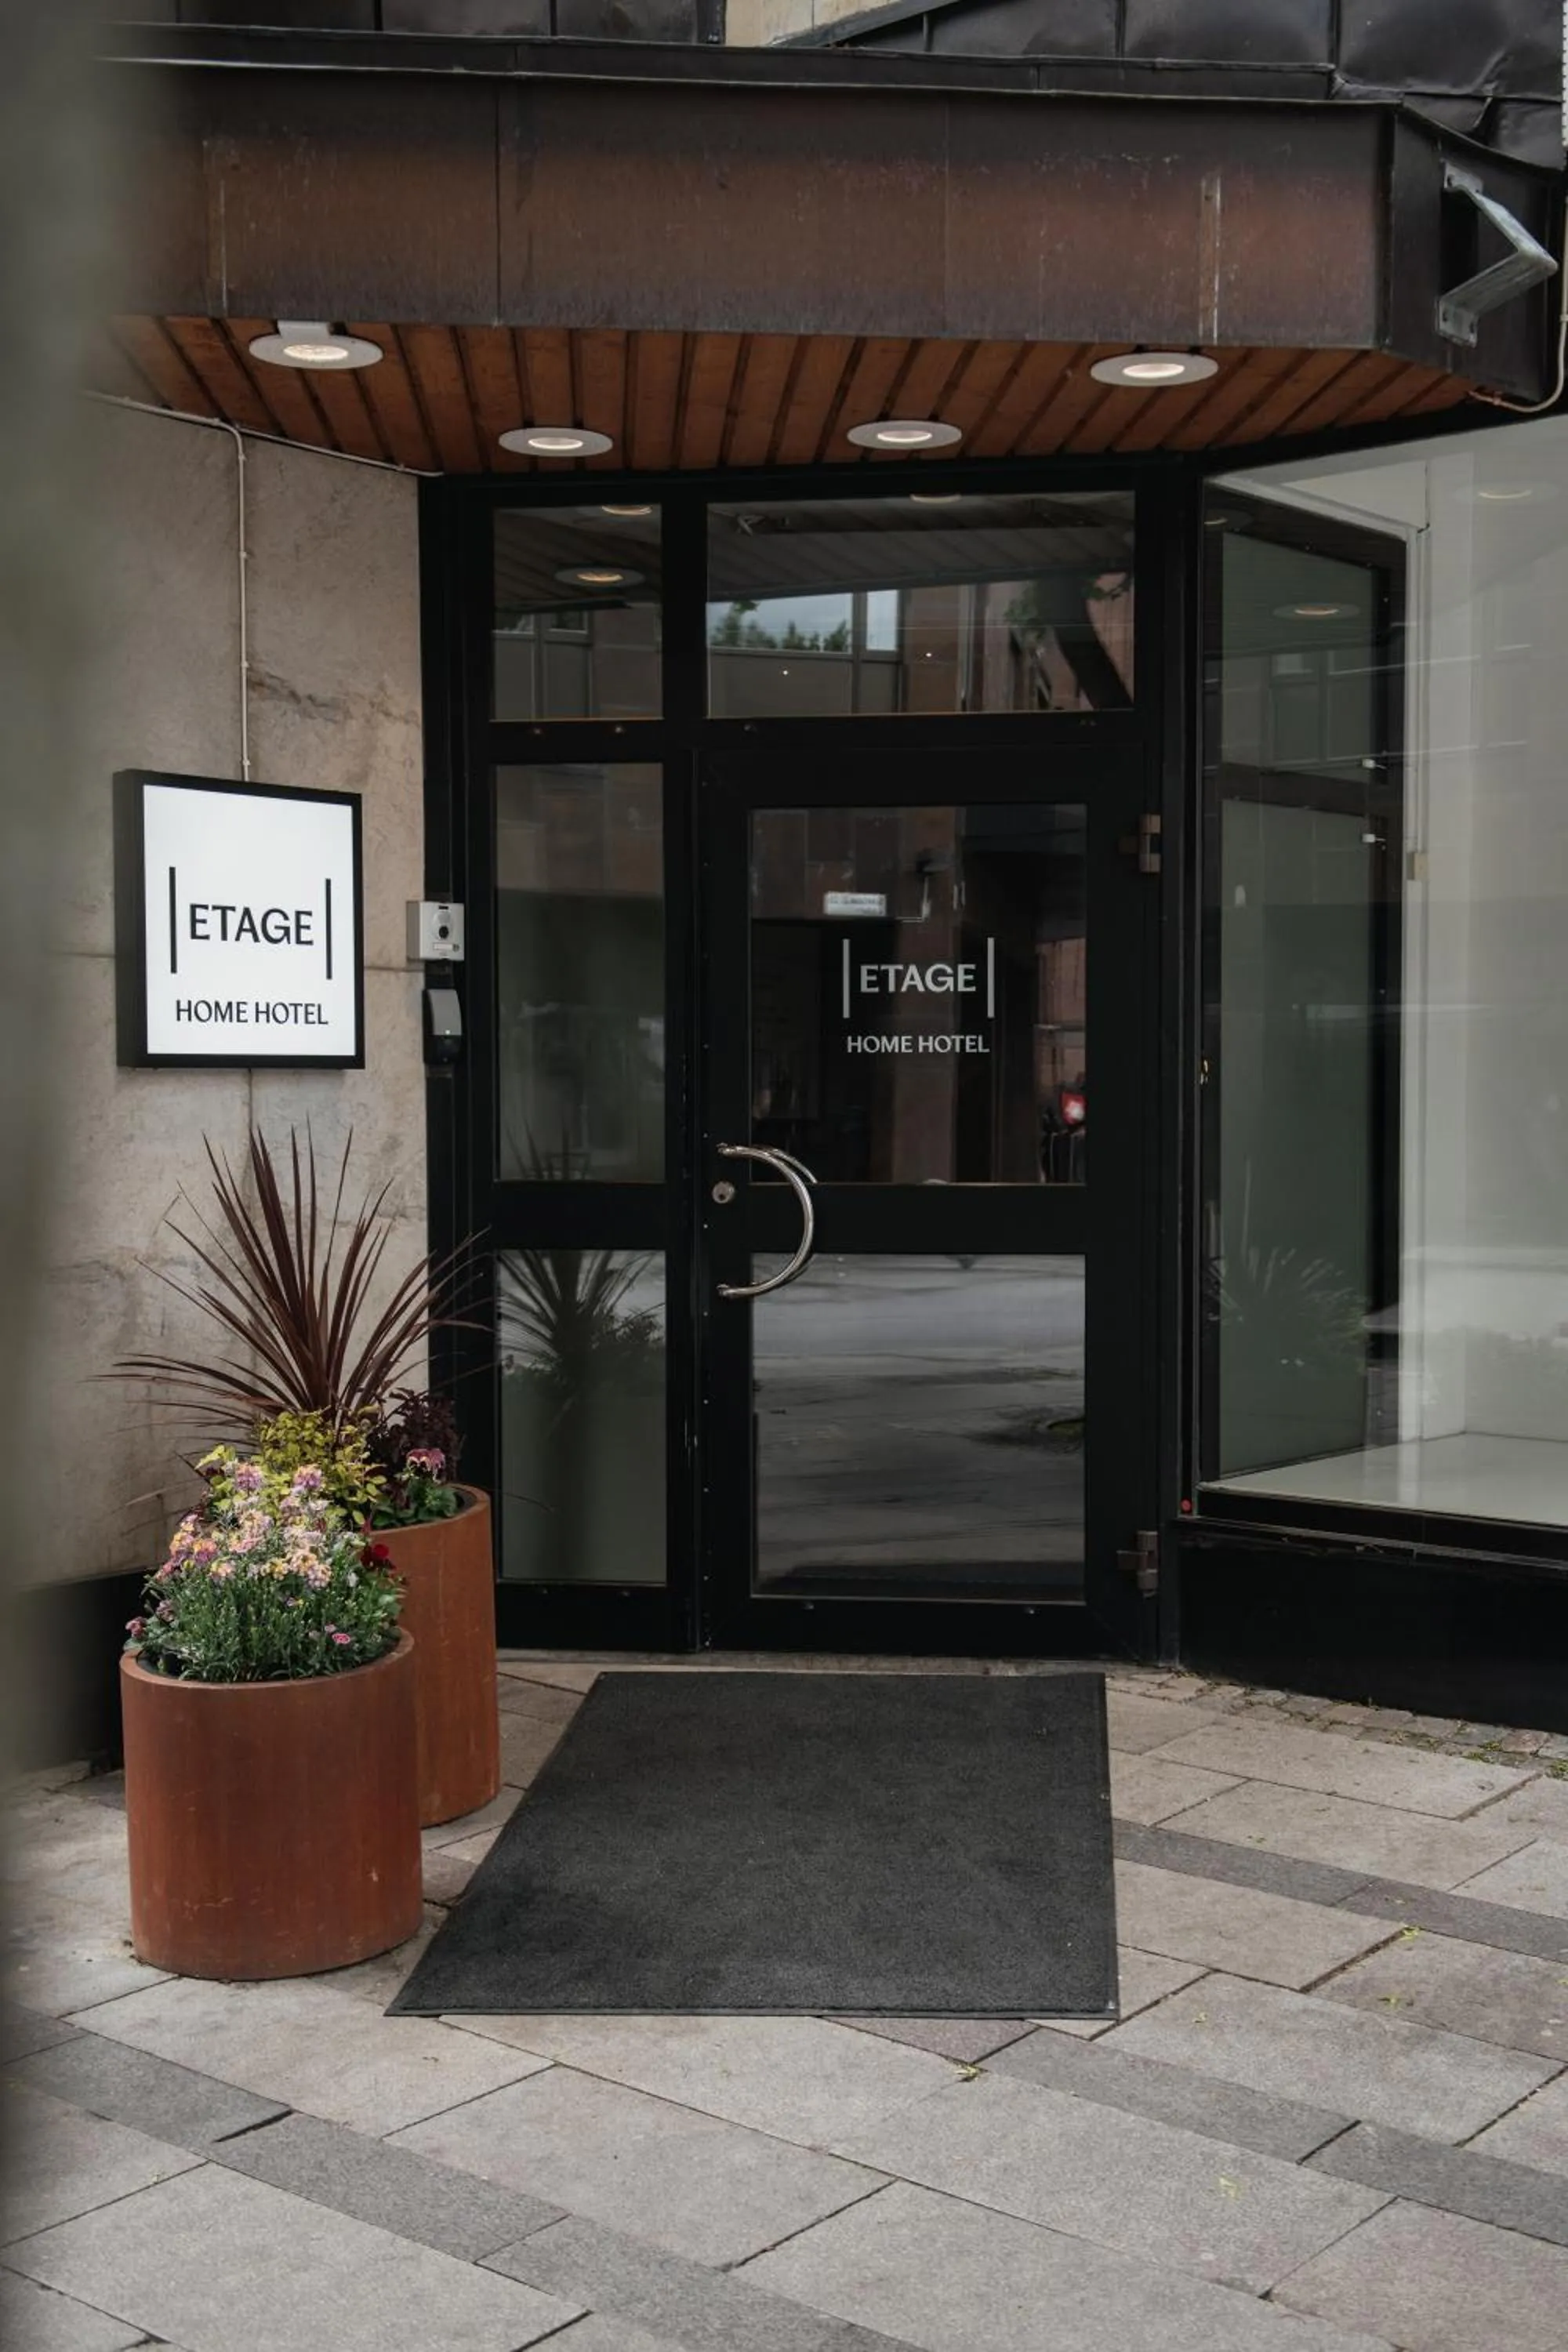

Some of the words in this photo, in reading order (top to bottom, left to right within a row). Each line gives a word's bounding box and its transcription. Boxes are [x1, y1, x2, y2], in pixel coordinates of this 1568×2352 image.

[189, 903, 314, 946] ETAGE
[860, 964, 977, 993] ETAGE
[176, 1000, 248, 1024] HOME
[255, 1001, 328, 1025] HOTEL
[848, 1035, 913, 1053] HOME
[918, 1035, 989, 1053] HOTEL
